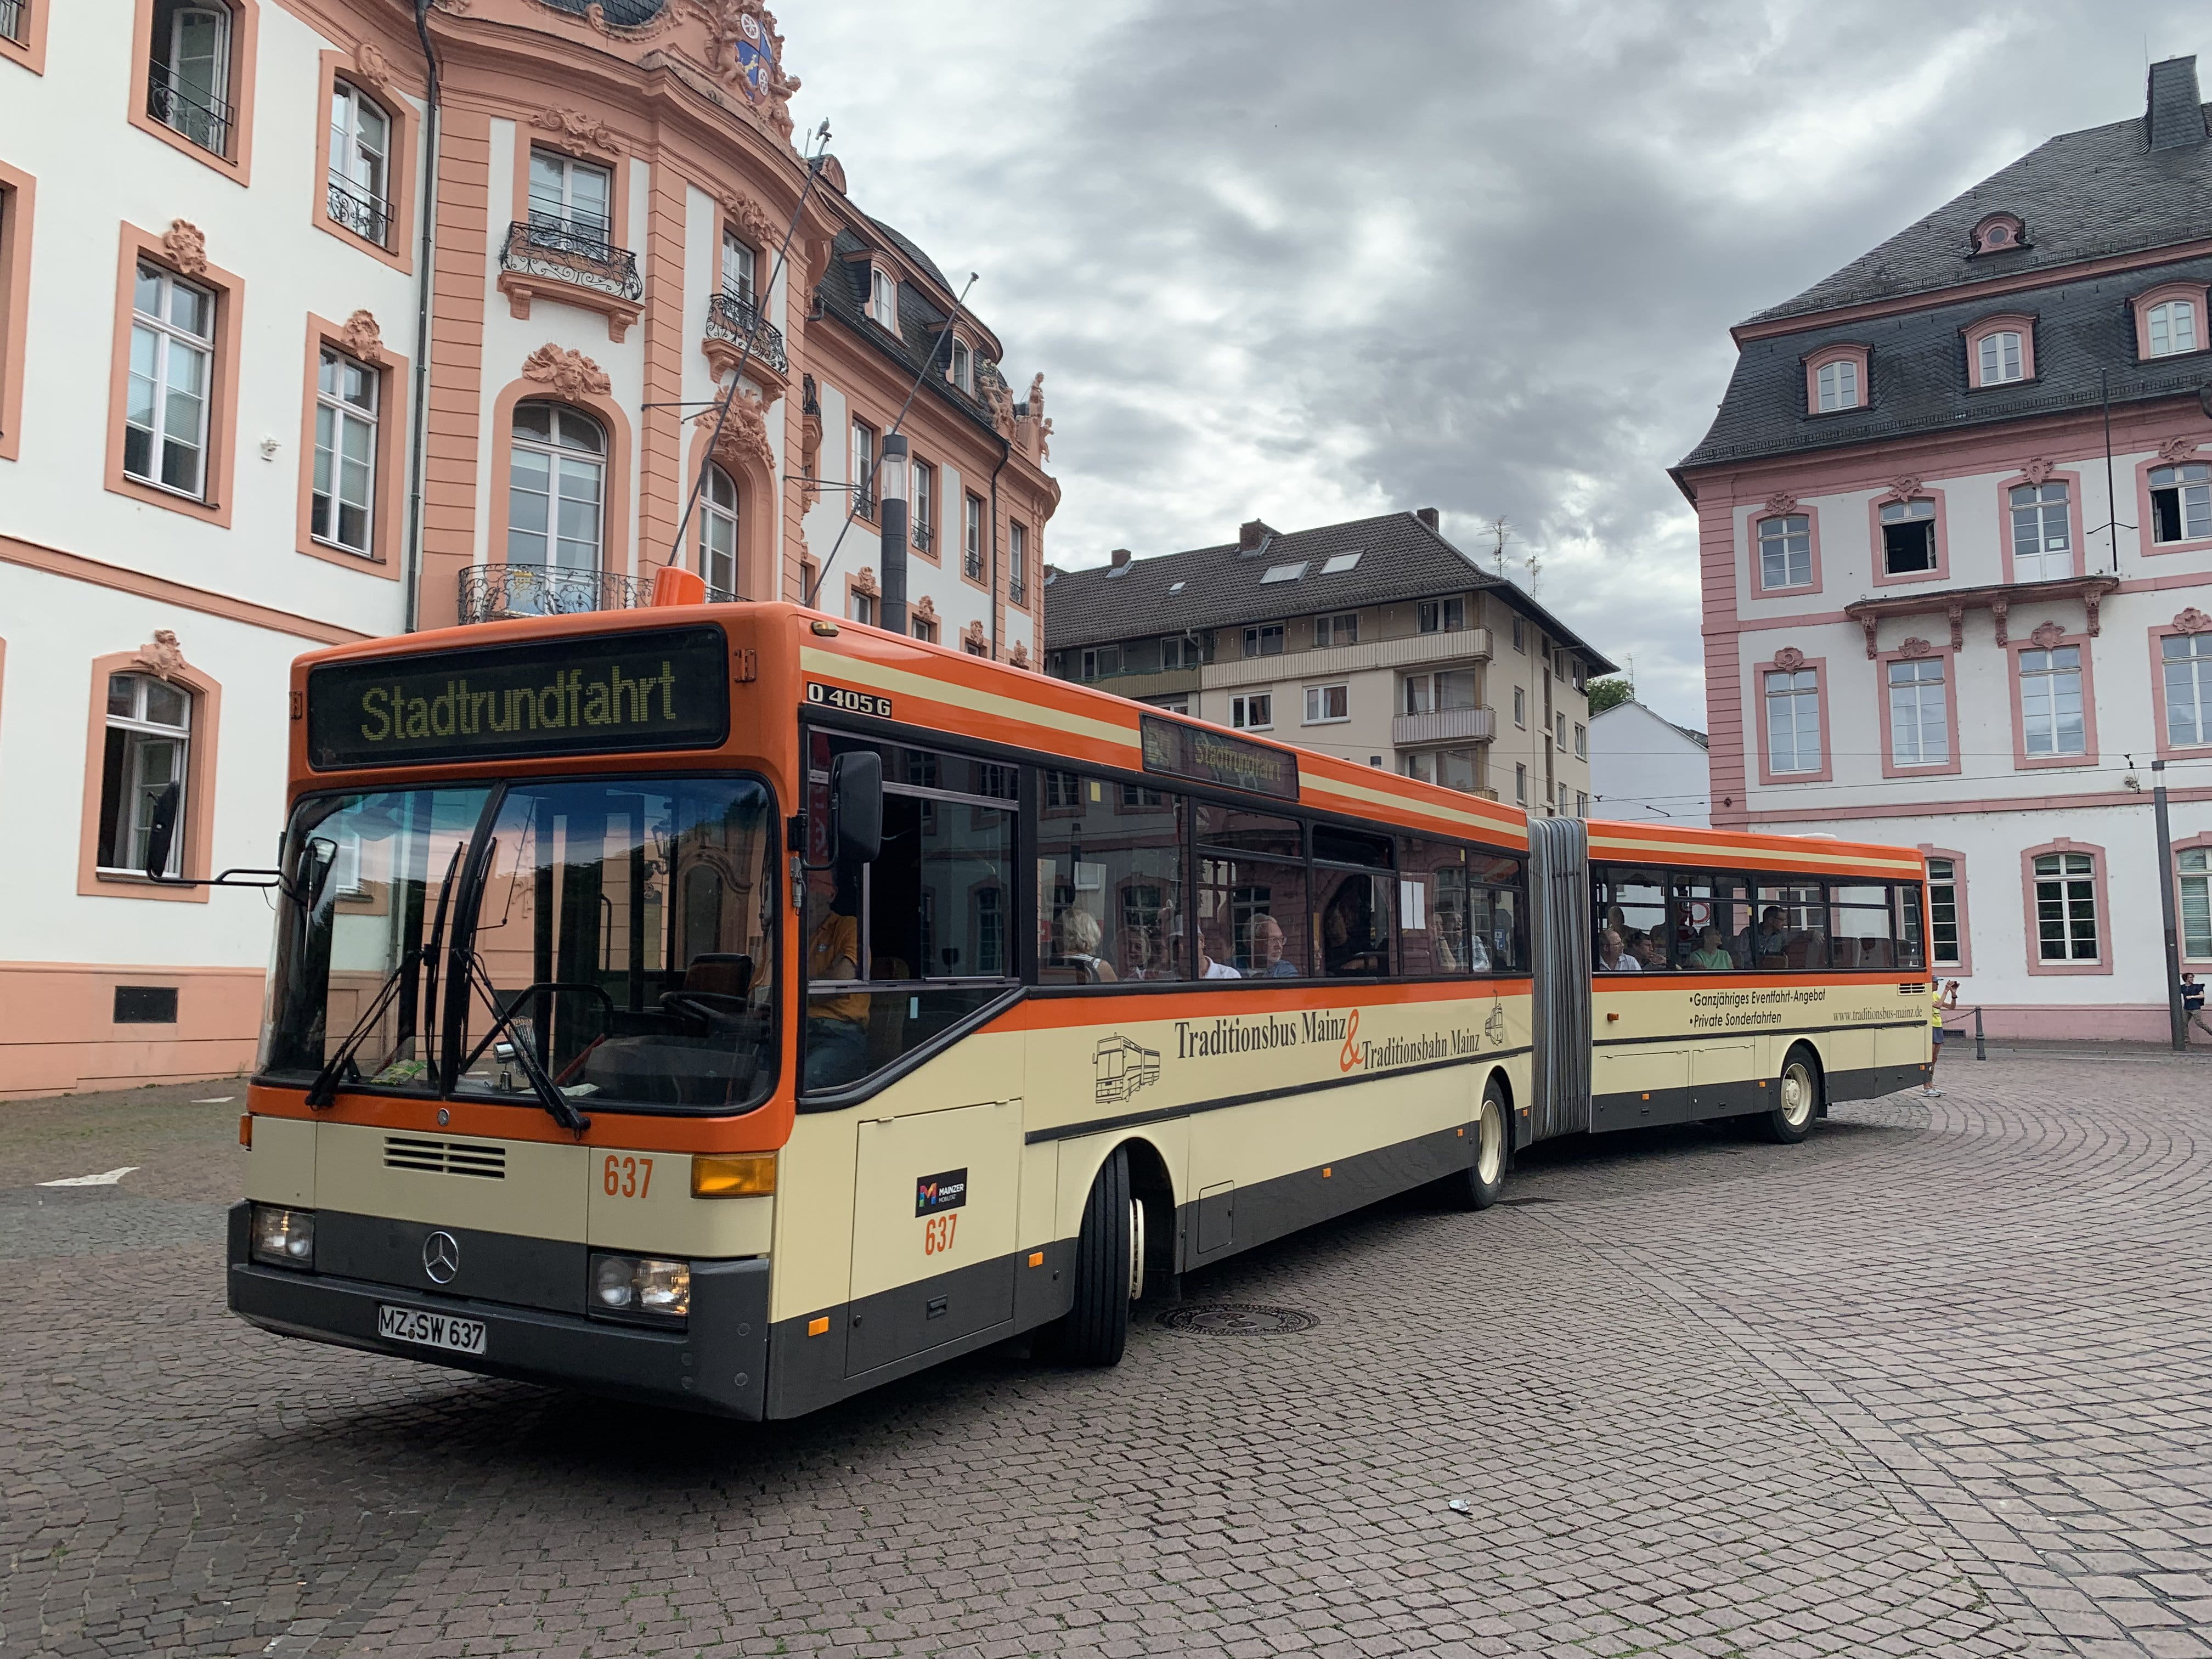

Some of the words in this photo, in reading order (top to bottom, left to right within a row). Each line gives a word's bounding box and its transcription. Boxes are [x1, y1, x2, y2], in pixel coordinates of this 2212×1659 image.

[360, 661, 675, 742] Stadtrundfahrt
[828, 690, 873, 713] 405
[877, 698, 890, 716] G
[1194, 741, 1282, 782] Stadtrundfahrt
[1694, 991, 1749, 1008] Ganzjähriges
[1752, 988, 1826, 1005] Eventfahrt-Angebot
[1833, 1005, 1922, 1022] www.traditionsbus-mainz.de
[1694, 1013, 1723, 1028] Private
[1725, 1011, 1782, 1026] Sonderfahrten
[1175, 1015, 1296, 1059] Traditionsbus
[1301, 1010, 1346, 1044] Mainz
[1340, 1008, 1365, 1072] &
[1362, 1032, 1447, 1070] Traditionsbahn
[1451, 1028, 1480, 1056] Mainz
[604, 1155, 653, 1199] 637
[939, 1183, 964, 1196] MAINZER
[925, 1213, 957, 1256] 637
[449, 1321, 484, 1350] 637
